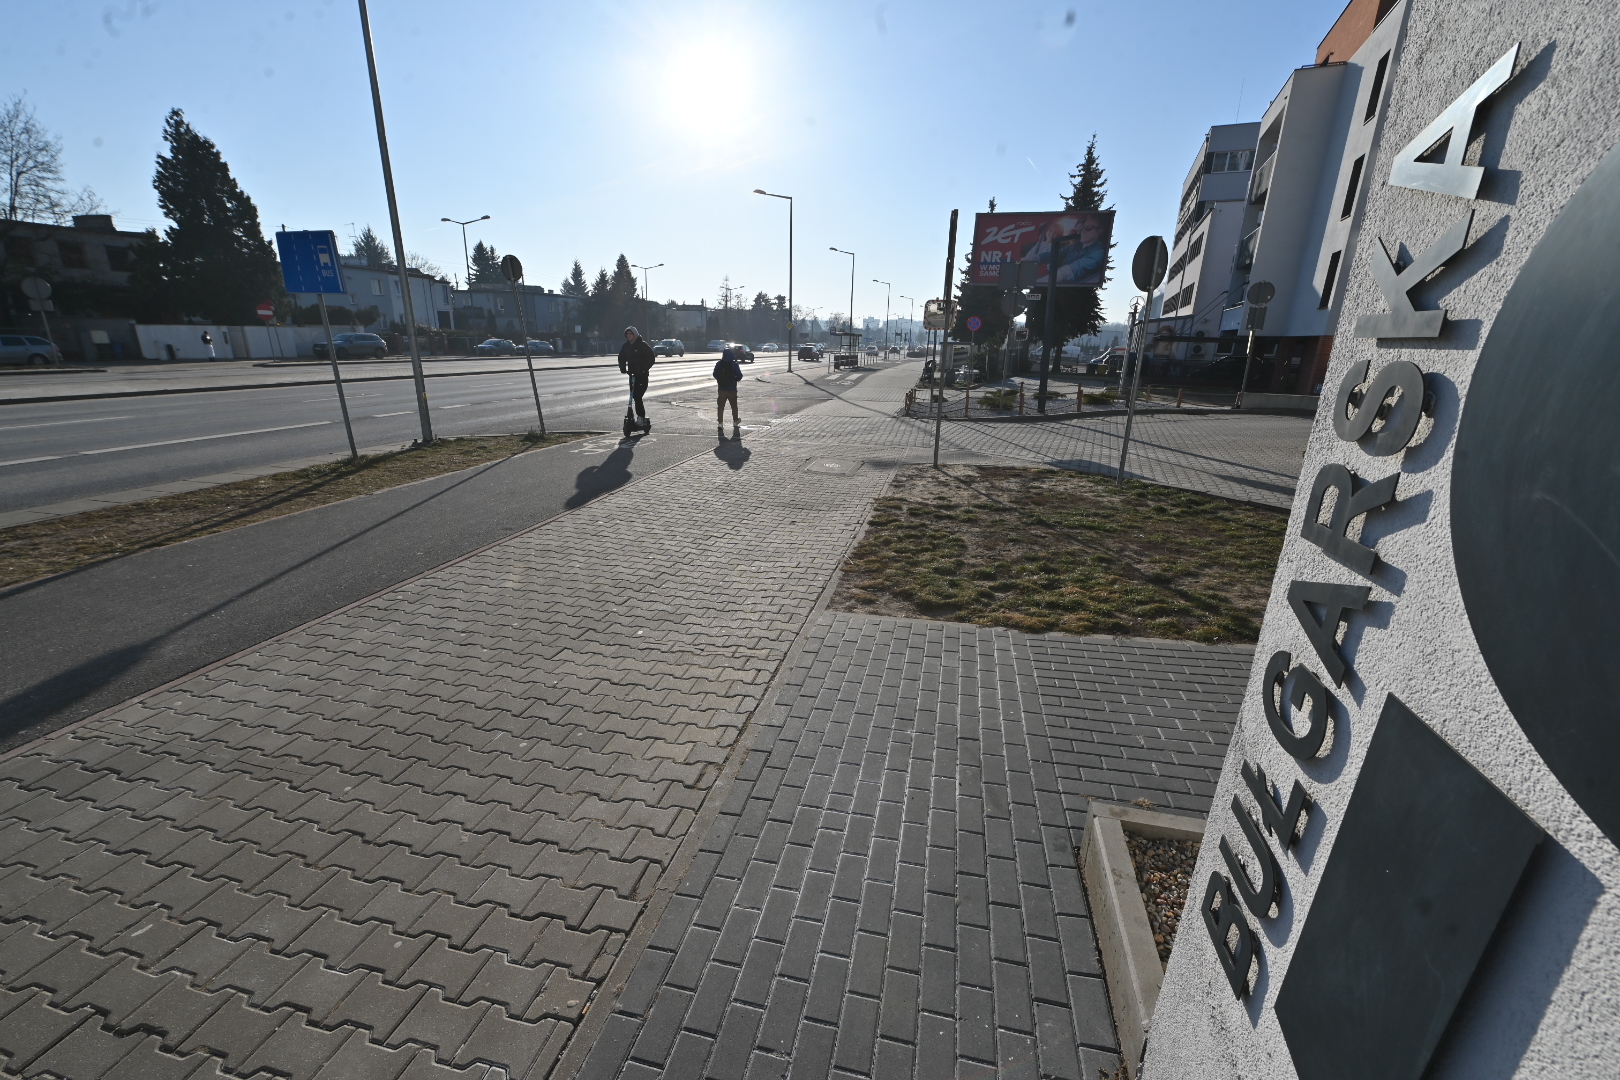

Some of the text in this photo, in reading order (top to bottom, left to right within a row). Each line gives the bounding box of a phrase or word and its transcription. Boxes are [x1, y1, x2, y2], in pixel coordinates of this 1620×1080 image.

[981, 224, 1036, 245] ZET
[980, 251, 1012, 263] NR 1
[322, 269, 334, 277] BUS
[1201, 42, 1520, 1001] BUŁGARSKA
